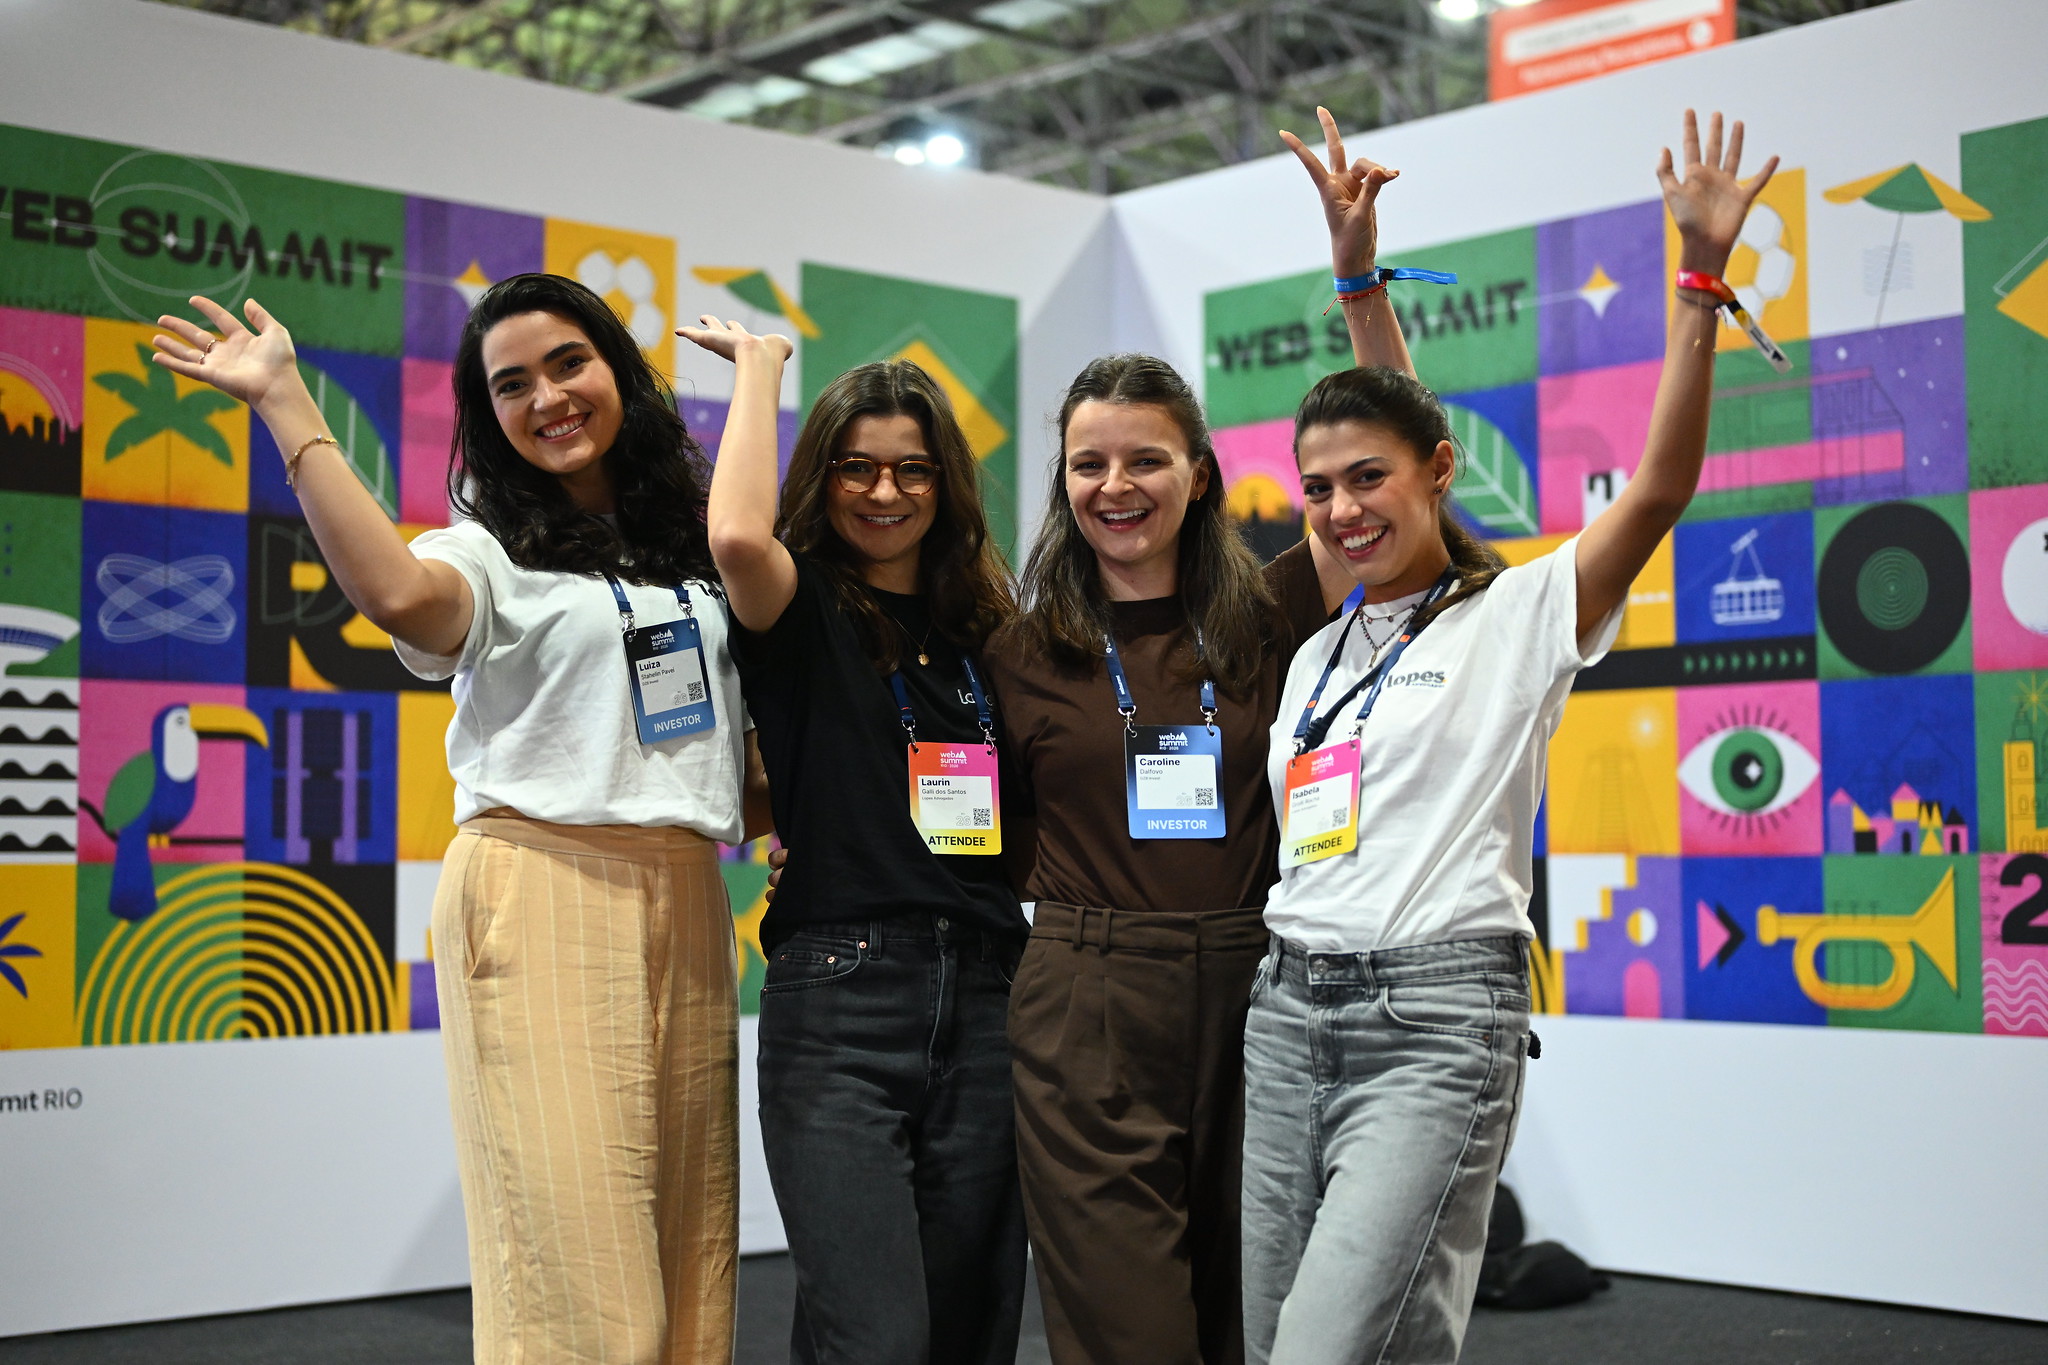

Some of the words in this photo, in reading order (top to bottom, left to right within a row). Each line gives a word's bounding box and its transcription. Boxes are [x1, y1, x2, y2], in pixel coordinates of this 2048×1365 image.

[0, 185, 97, 249] EB
[119, 206, 393, 292] SUMMIT
[1217, 321, 1312, 372] WEB
[1325, 281, 1528, 355] SMMIT
[651, 637, 675, 647] summit
[639, 660, 661, 672] Luiza
[653, 714, 702, 733] INVESTOR
[1158, 732, 1175, 741] web
[940, 750, 956, 758] web
[940, 756, 967, 765] summit
[1139, 757, 1181, 766] Caroline
[921, 778, 950, 787] Laurin
[1292, 786, 1320, 800] Isabela
[1147, 819, 1208, 830] INVESTOR
[928, 835, 986, 847] ATTENDEE
[1293, 836, 1343, 858] ATTENDEE
[43, 1087, 83, 1111] RIO
